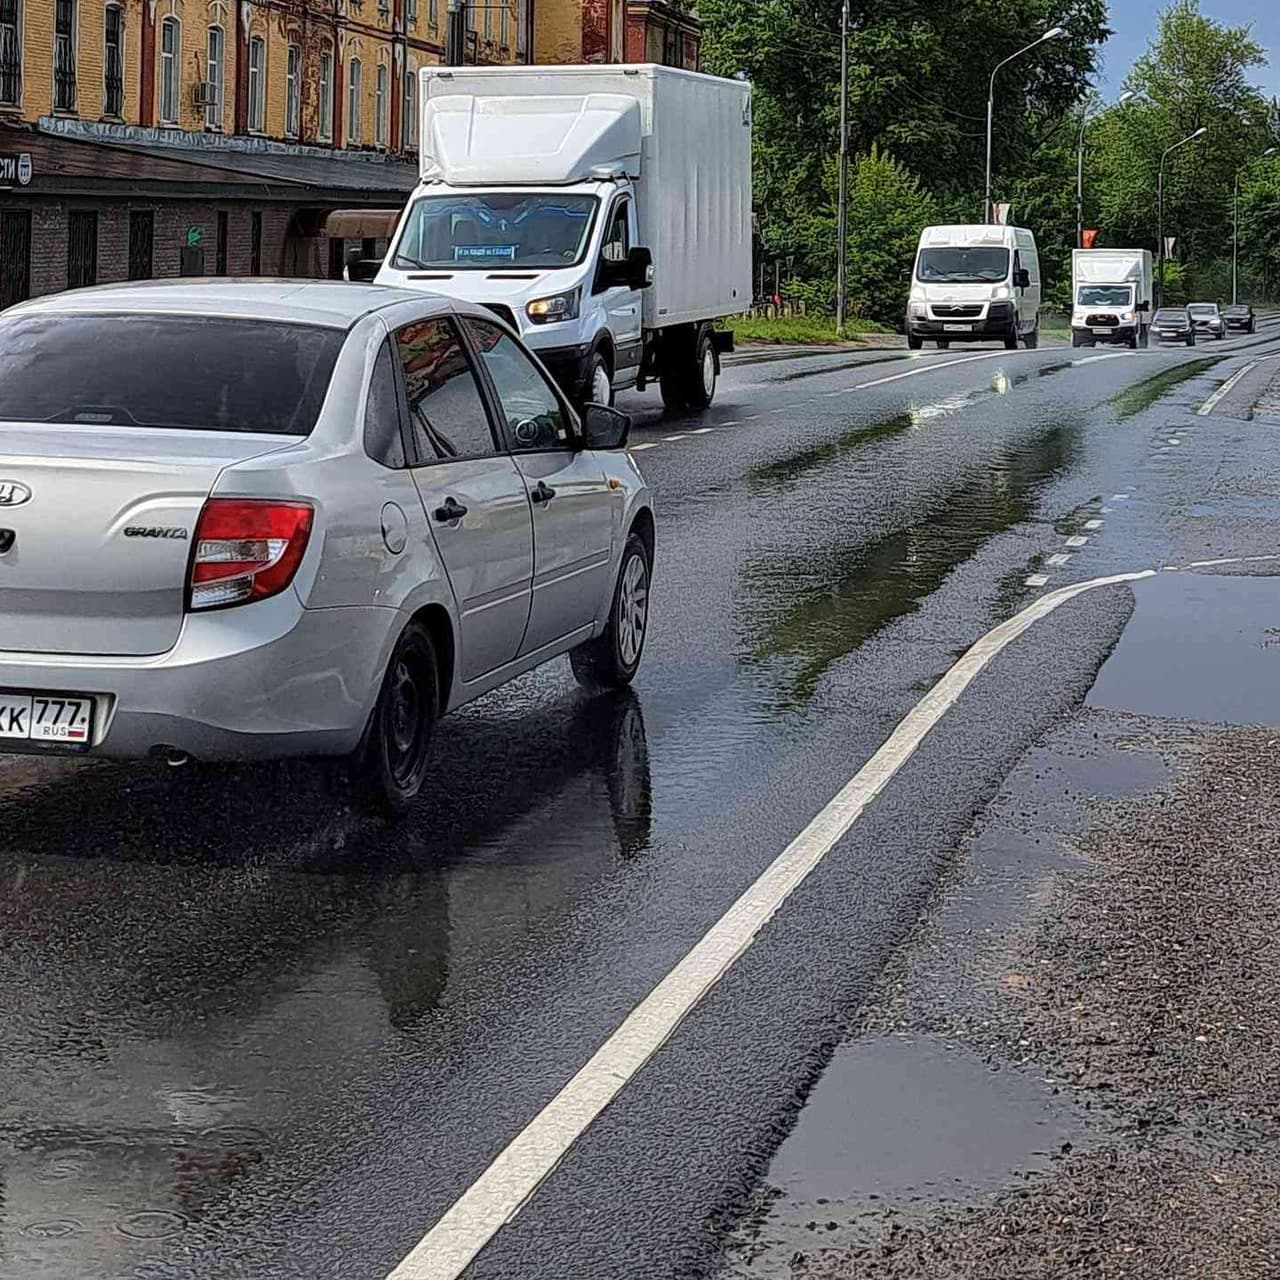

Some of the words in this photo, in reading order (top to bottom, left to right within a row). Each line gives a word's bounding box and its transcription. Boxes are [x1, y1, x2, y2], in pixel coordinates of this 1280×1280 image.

[123, 526, 188, 540] GRANTA
[35, 699, 82, 726] 777
[43, 727, 67, 737] RUS
